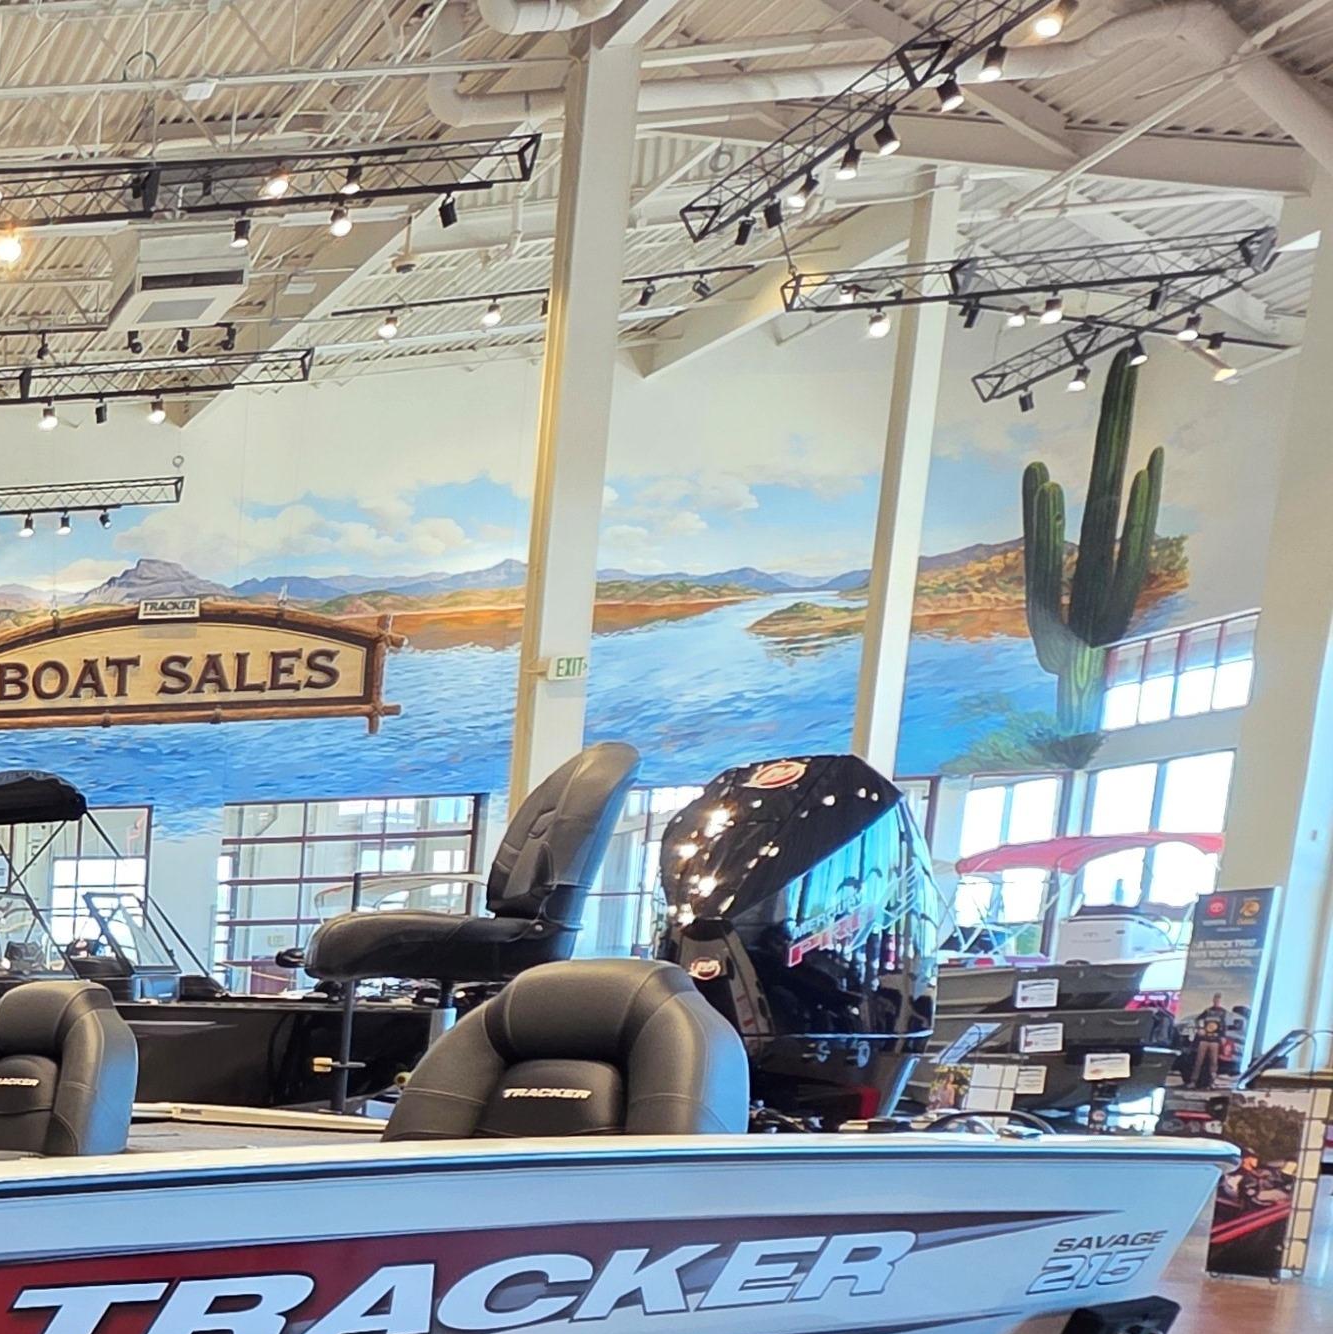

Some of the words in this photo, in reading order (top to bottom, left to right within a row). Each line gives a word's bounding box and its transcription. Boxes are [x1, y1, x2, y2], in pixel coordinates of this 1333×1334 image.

[143, 601, 196, 611] TRACKER
[157, 647, 341, 695] SALES
[556, 656, 584, 677] EXIT
[792, 892, 862, 940] MERCURY
[502, 1087, 592, 1099] TRACKER
[1053, 1230, 1168, 1253] SAVAGE
[1025, 1248, 1156, 1295] 215
